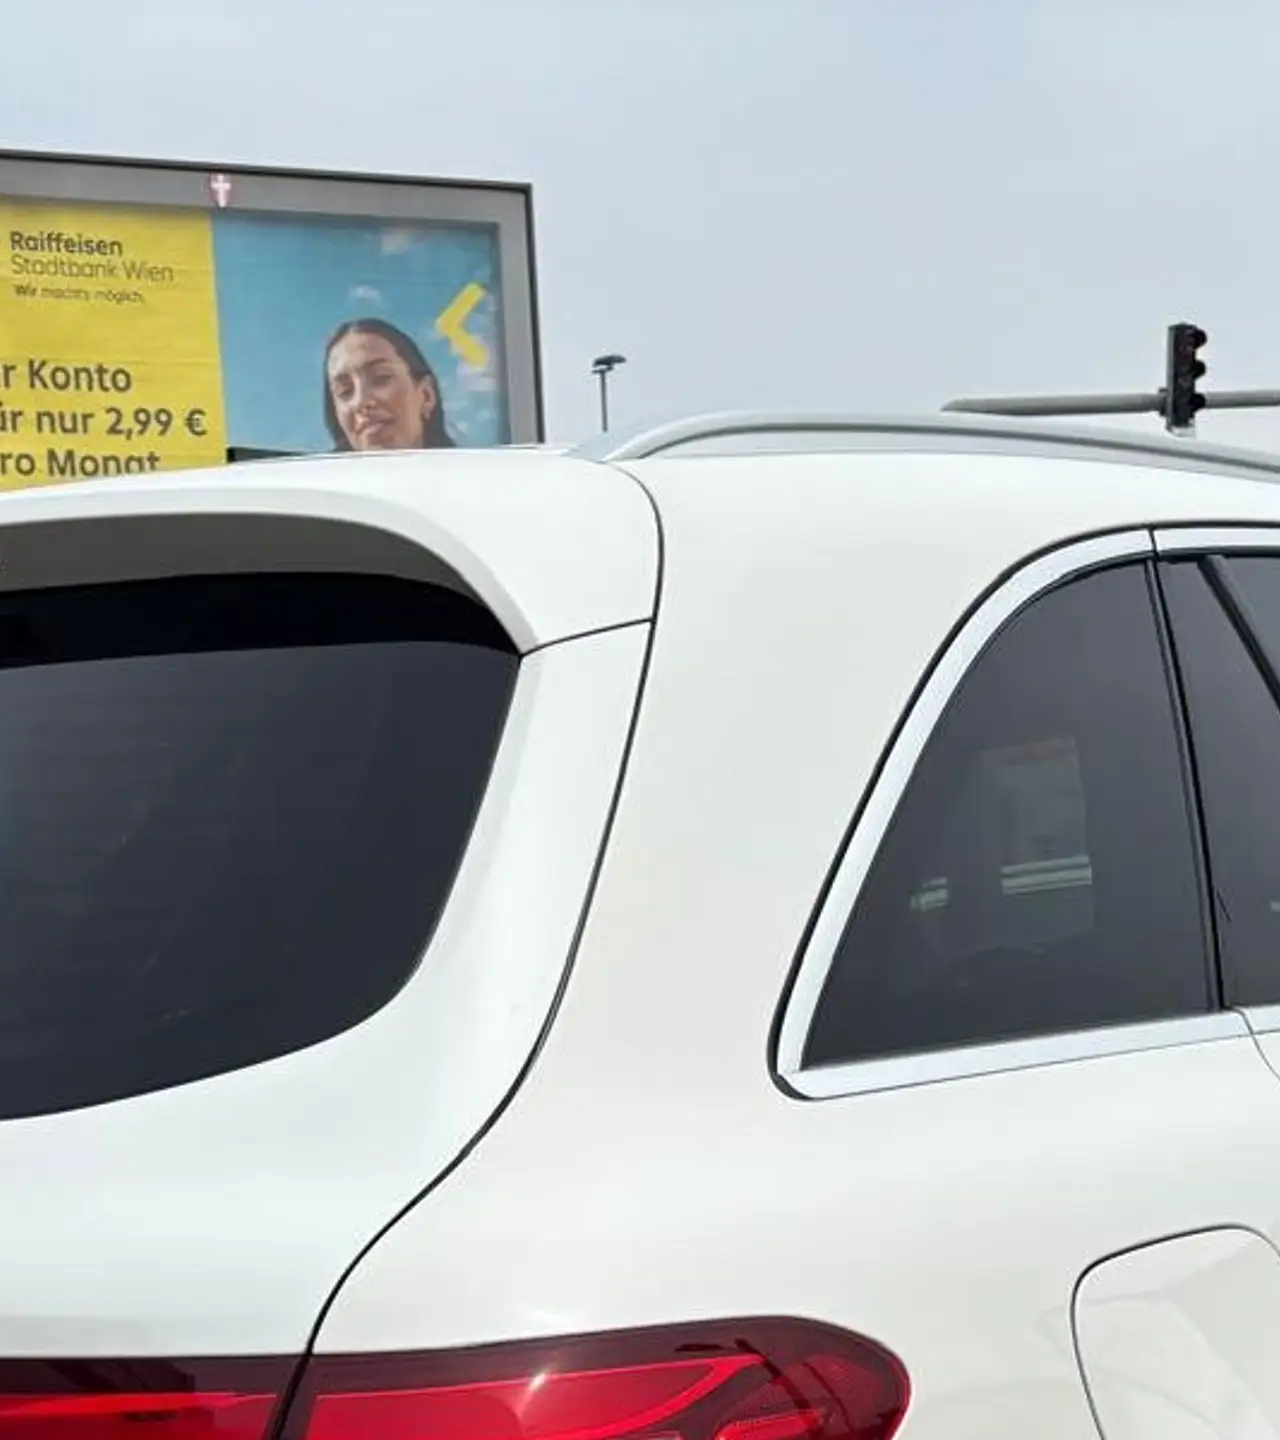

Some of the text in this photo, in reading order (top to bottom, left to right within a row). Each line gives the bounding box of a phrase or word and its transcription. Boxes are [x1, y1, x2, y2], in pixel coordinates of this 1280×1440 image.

[10, 231, 123, 256] Raiffeisen
[10, 253, 174, 282] Stadtbank Wien
[28, 359, 132, 392] Konto
[36, 410, 95, 435] nur
[105, 407, 174, 441] 2,99
[184, 408, 208, 436] €
[47, 448, 161, 477] Monat
